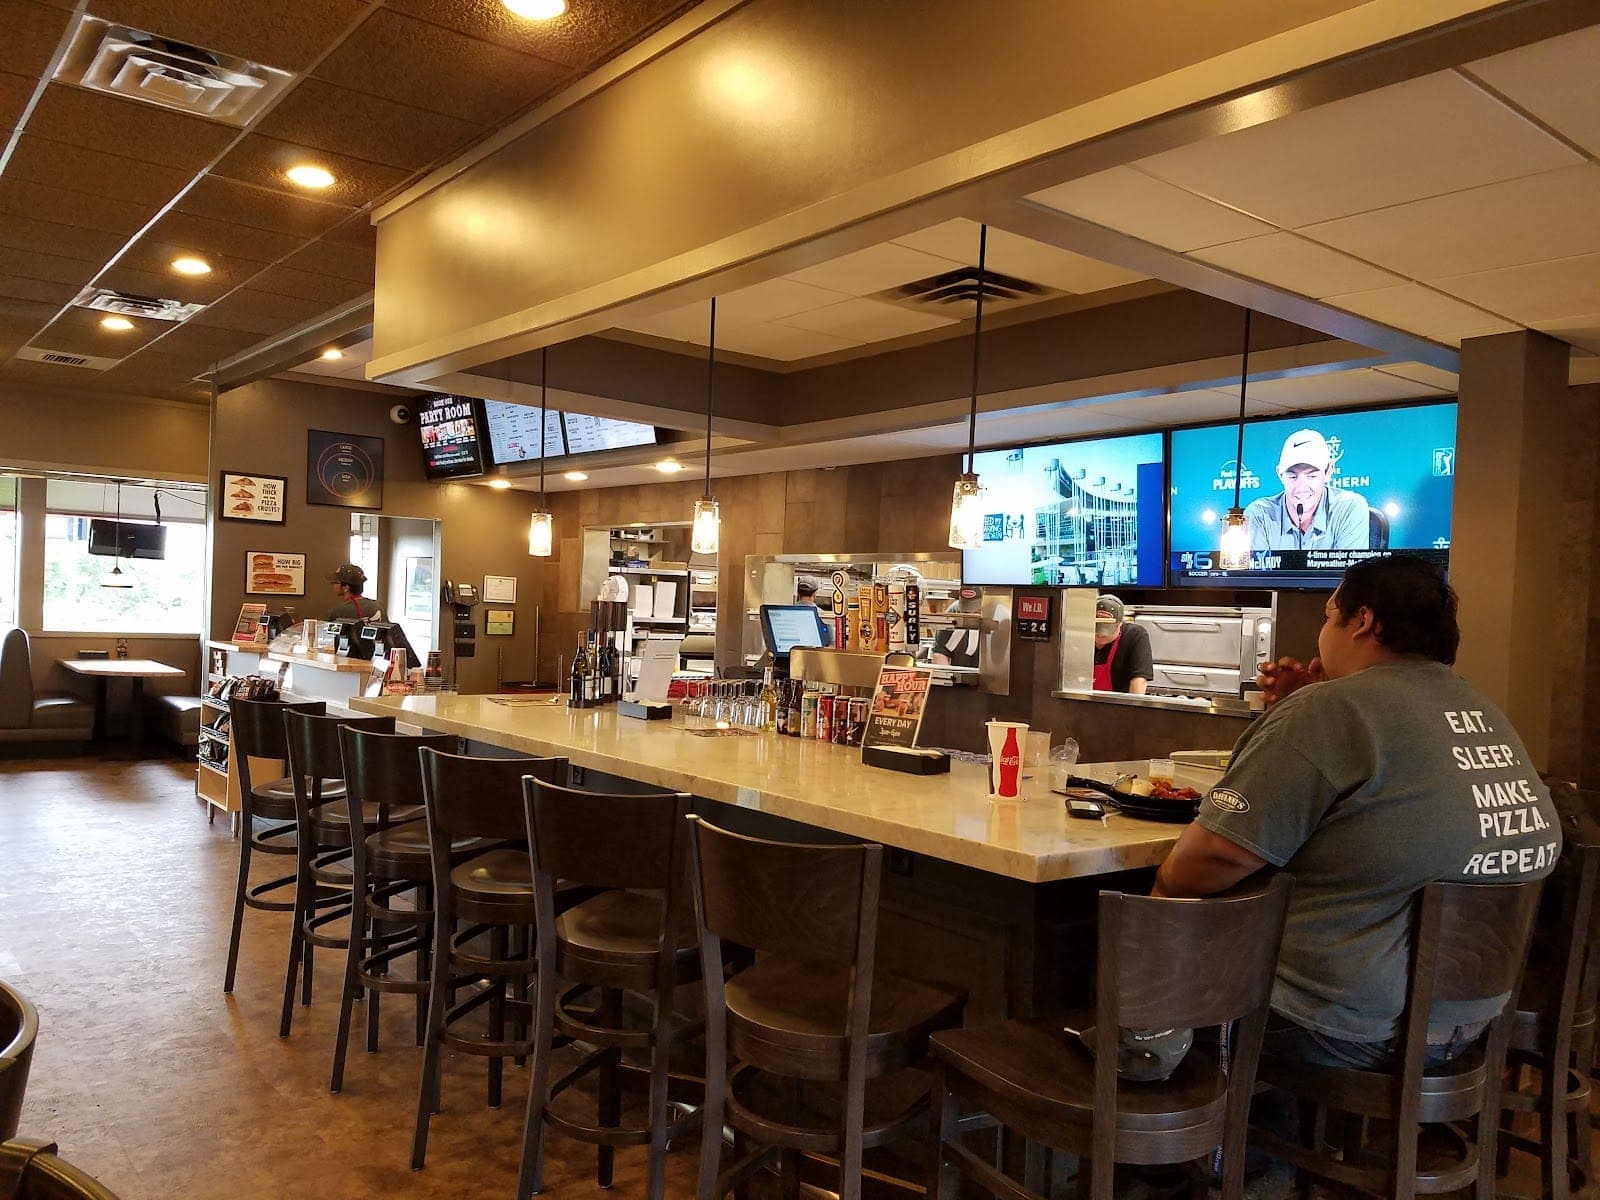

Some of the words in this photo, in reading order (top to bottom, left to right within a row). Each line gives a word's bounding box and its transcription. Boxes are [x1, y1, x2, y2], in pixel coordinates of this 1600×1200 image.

[419, 408, 443, 425] PARTY
[444, 402, 472, 420] ROOM
[257, 505, 280, 513] CRUSTS?
[261, 499, 277, 507] PIZZA
[1307, 550, 1328, 559] 4-time
[1329, 551, 1348, 560] major
[1348, 551, 1382, 560] champion
[1306, 559, 1363, 569] Mayweather-Mc
[1022, 601, 1033, 613] We
[907, 601, 917, 640] SURLY
[881, 672, 916, 684] HAPPY
[896, 680, 926, 691] HOUR
[874, 716, 896, 727] EVERY
[896, 719, 912, 729] DAY
[1443, 710, 1494, 734] EAT.
[1452, 744, 1522, 770] SLEEP.
[1471, 779, 1539, 809] MAKE
[1478, 806, 1550, 838] PIZZA.
